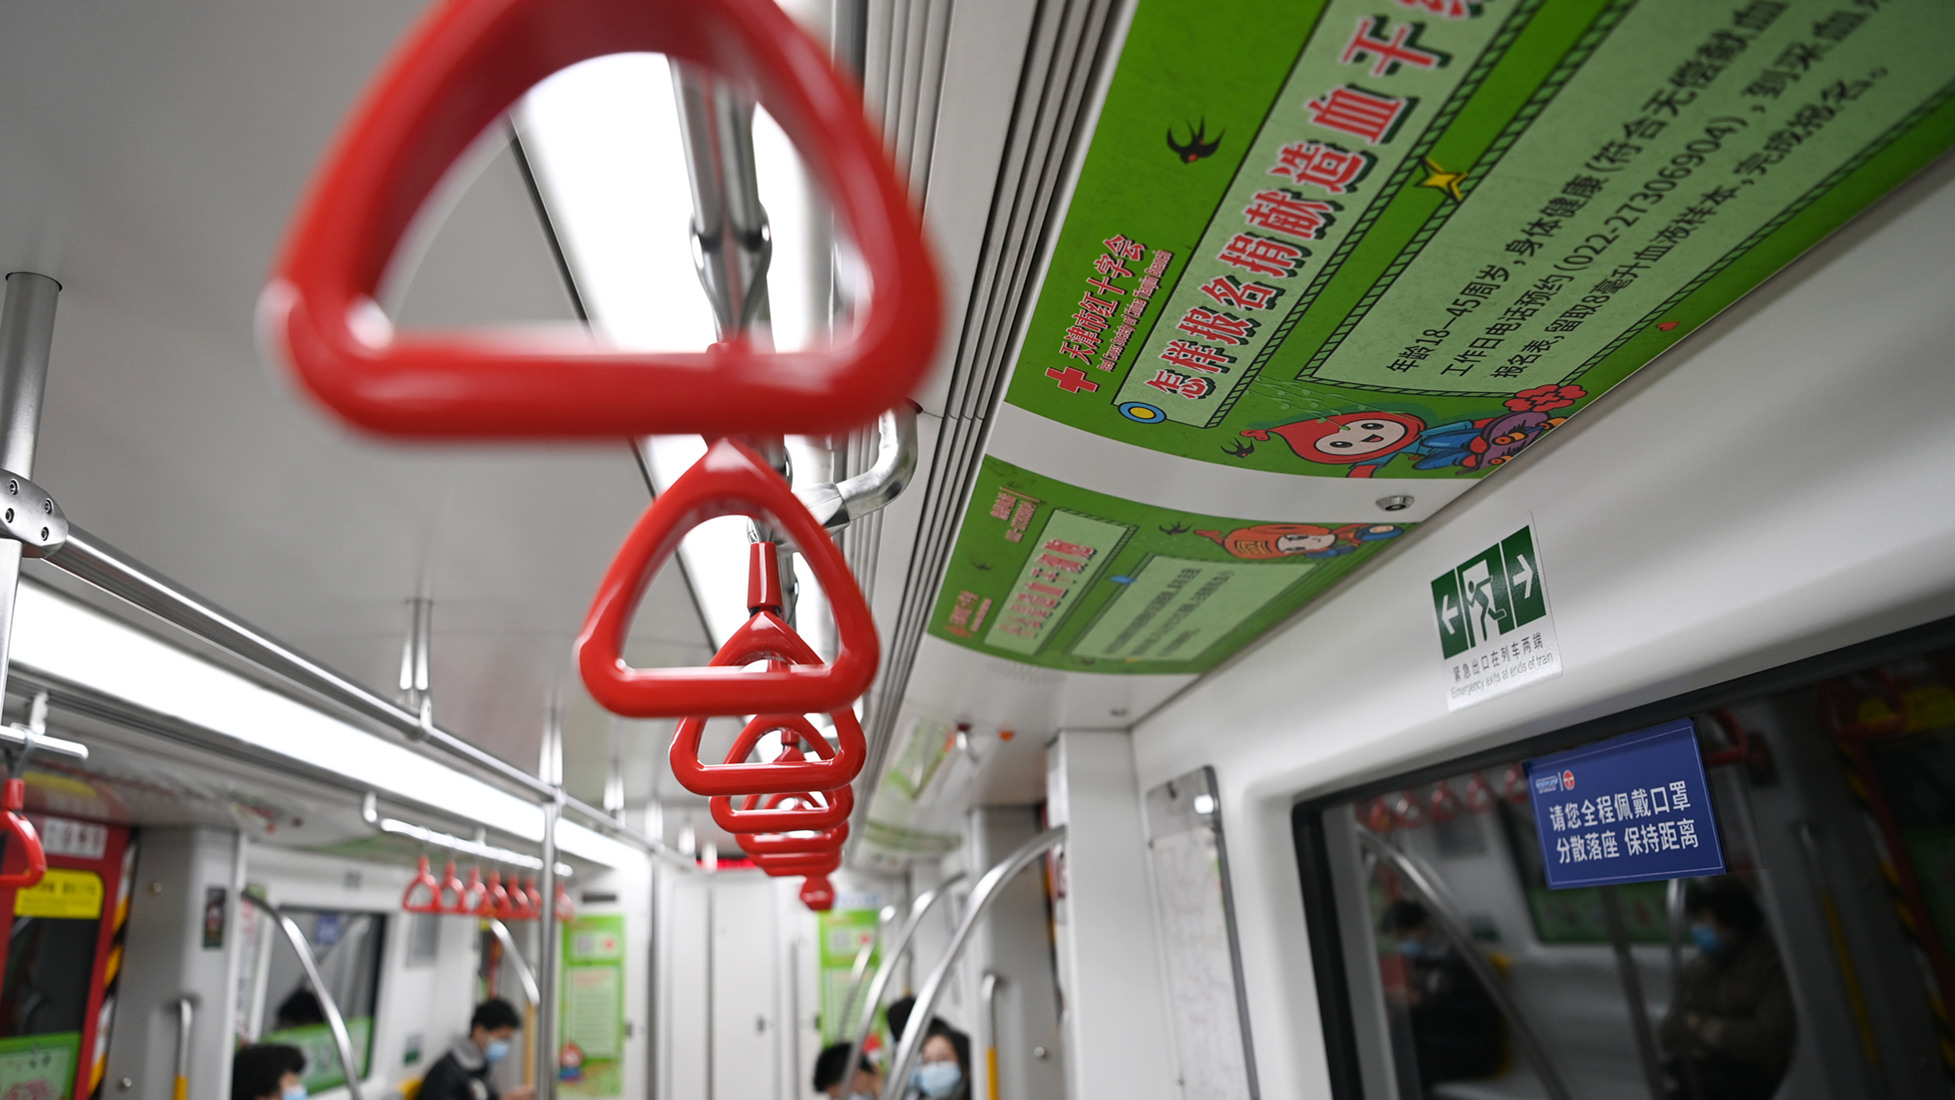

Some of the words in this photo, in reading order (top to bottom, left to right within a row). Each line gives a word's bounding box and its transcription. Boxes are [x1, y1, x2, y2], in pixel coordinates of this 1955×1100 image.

[1144, 0, 1484, 399] 怎样报名捐献造血干
[1059, 234, 1147, 365] 天津市红十字会
[1453, 632, 1543, 683] 紧急出口在列车两端
[1536, 651, 1554, 666] train
[1549, 780, 1691, 832] 请您全程佩戴口罩
[1556, 830, 1620, 864] 分散落座
[1625, 818, 1699, 856] 保持距离
